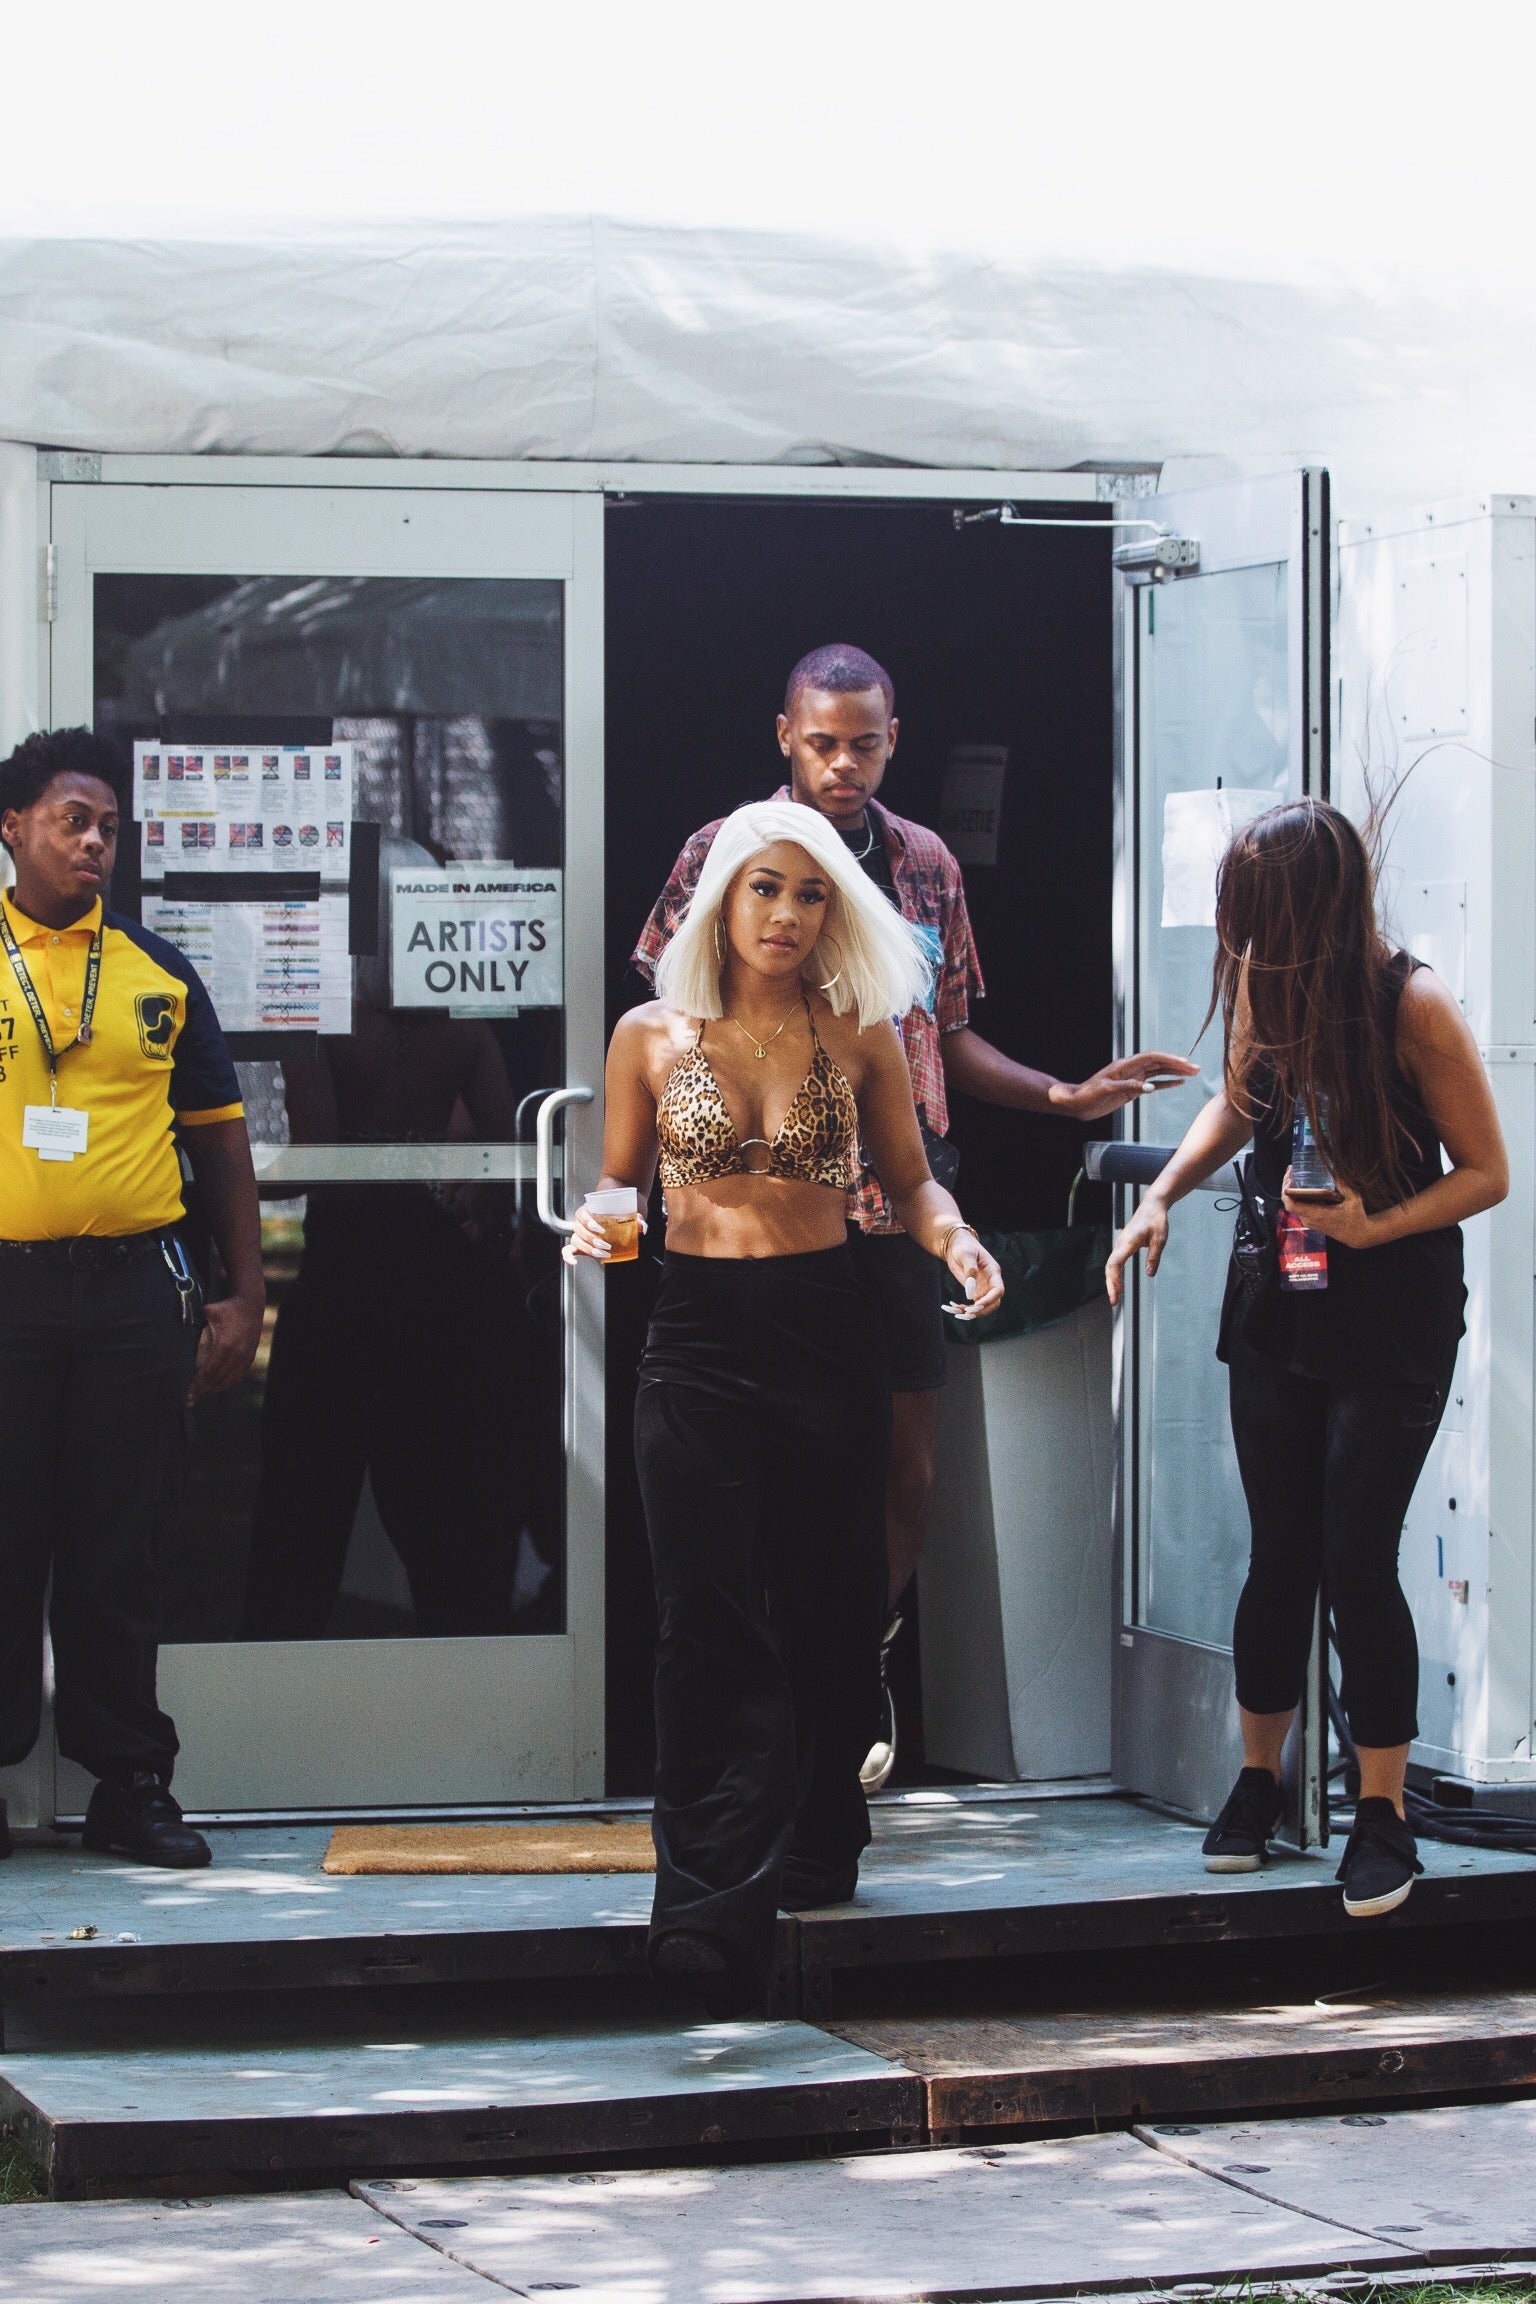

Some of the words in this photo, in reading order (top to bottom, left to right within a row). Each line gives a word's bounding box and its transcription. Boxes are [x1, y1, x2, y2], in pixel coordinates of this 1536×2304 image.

[396, 884, 449, 893] MADE
[452, 883, 470, 893] IN
[474, 883, 557, 893] AMERICA
[407, 919, 546, 952] ARTISTS
[425, 960, 529, 993] ONLY
[0, 1018, 15, 1040] 7
[1285, 1261, 1320, 1269] ACCESS
